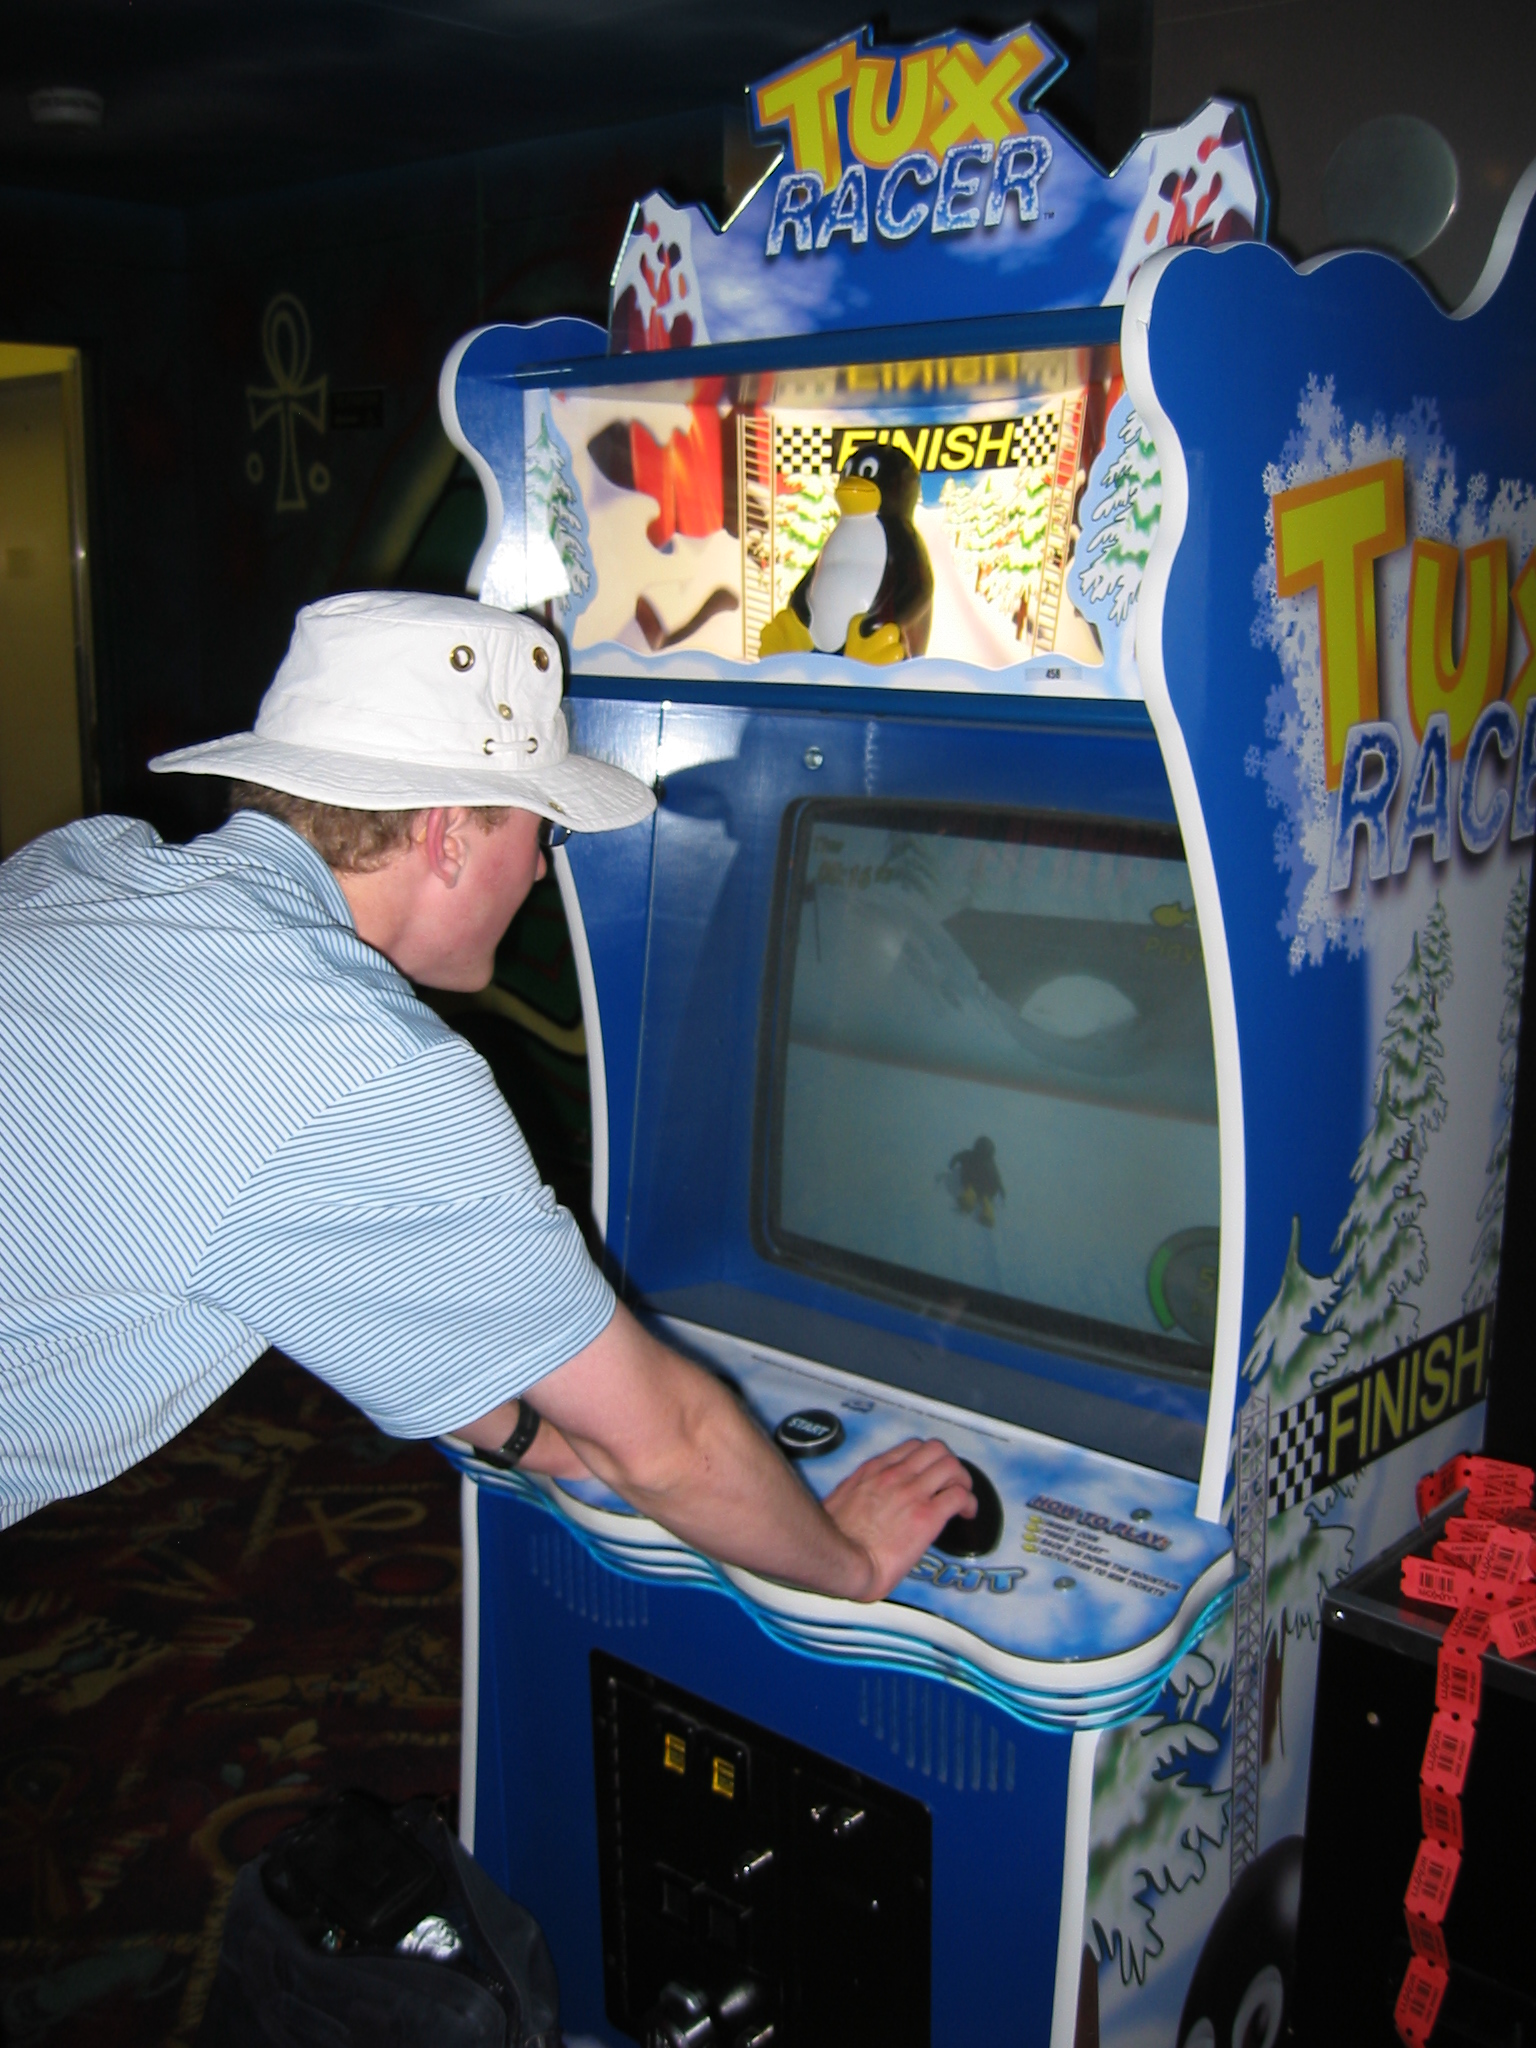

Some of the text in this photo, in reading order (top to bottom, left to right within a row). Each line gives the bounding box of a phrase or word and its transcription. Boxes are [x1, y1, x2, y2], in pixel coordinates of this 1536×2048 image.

[757, 33, 1045, 195] TUX
[765, 135, 1053, 257] RACER
[787, 1416, 830, 1437] START
[1327, 1313, 1487, 1477] FINISH
[1027, 1494, 1081, 1520] HOW
[1078, 1511, 1111, 1530] TO
